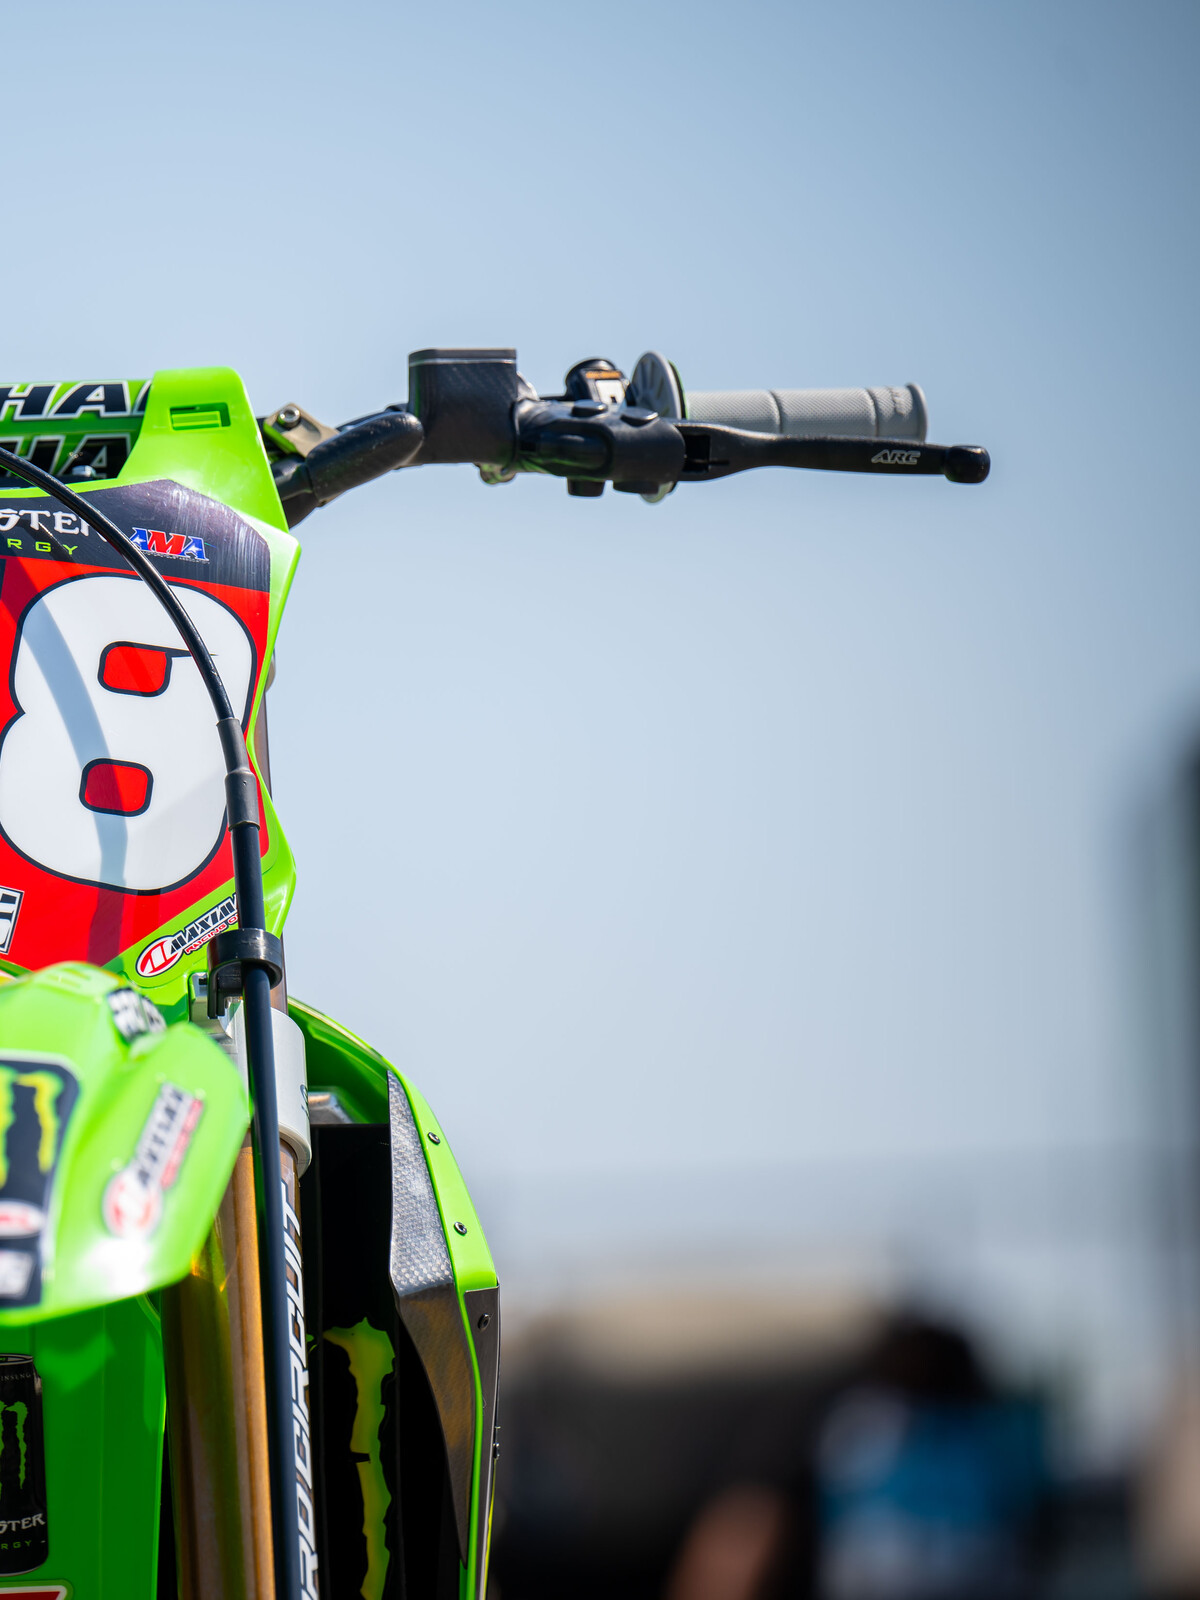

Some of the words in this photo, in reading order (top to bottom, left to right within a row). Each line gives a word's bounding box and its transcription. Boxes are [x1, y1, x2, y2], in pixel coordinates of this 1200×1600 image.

[871, 449, 920, 465] ARC
[129, 527, 210, 562] AMA
[170, 893, 238, 955] MAXIM
